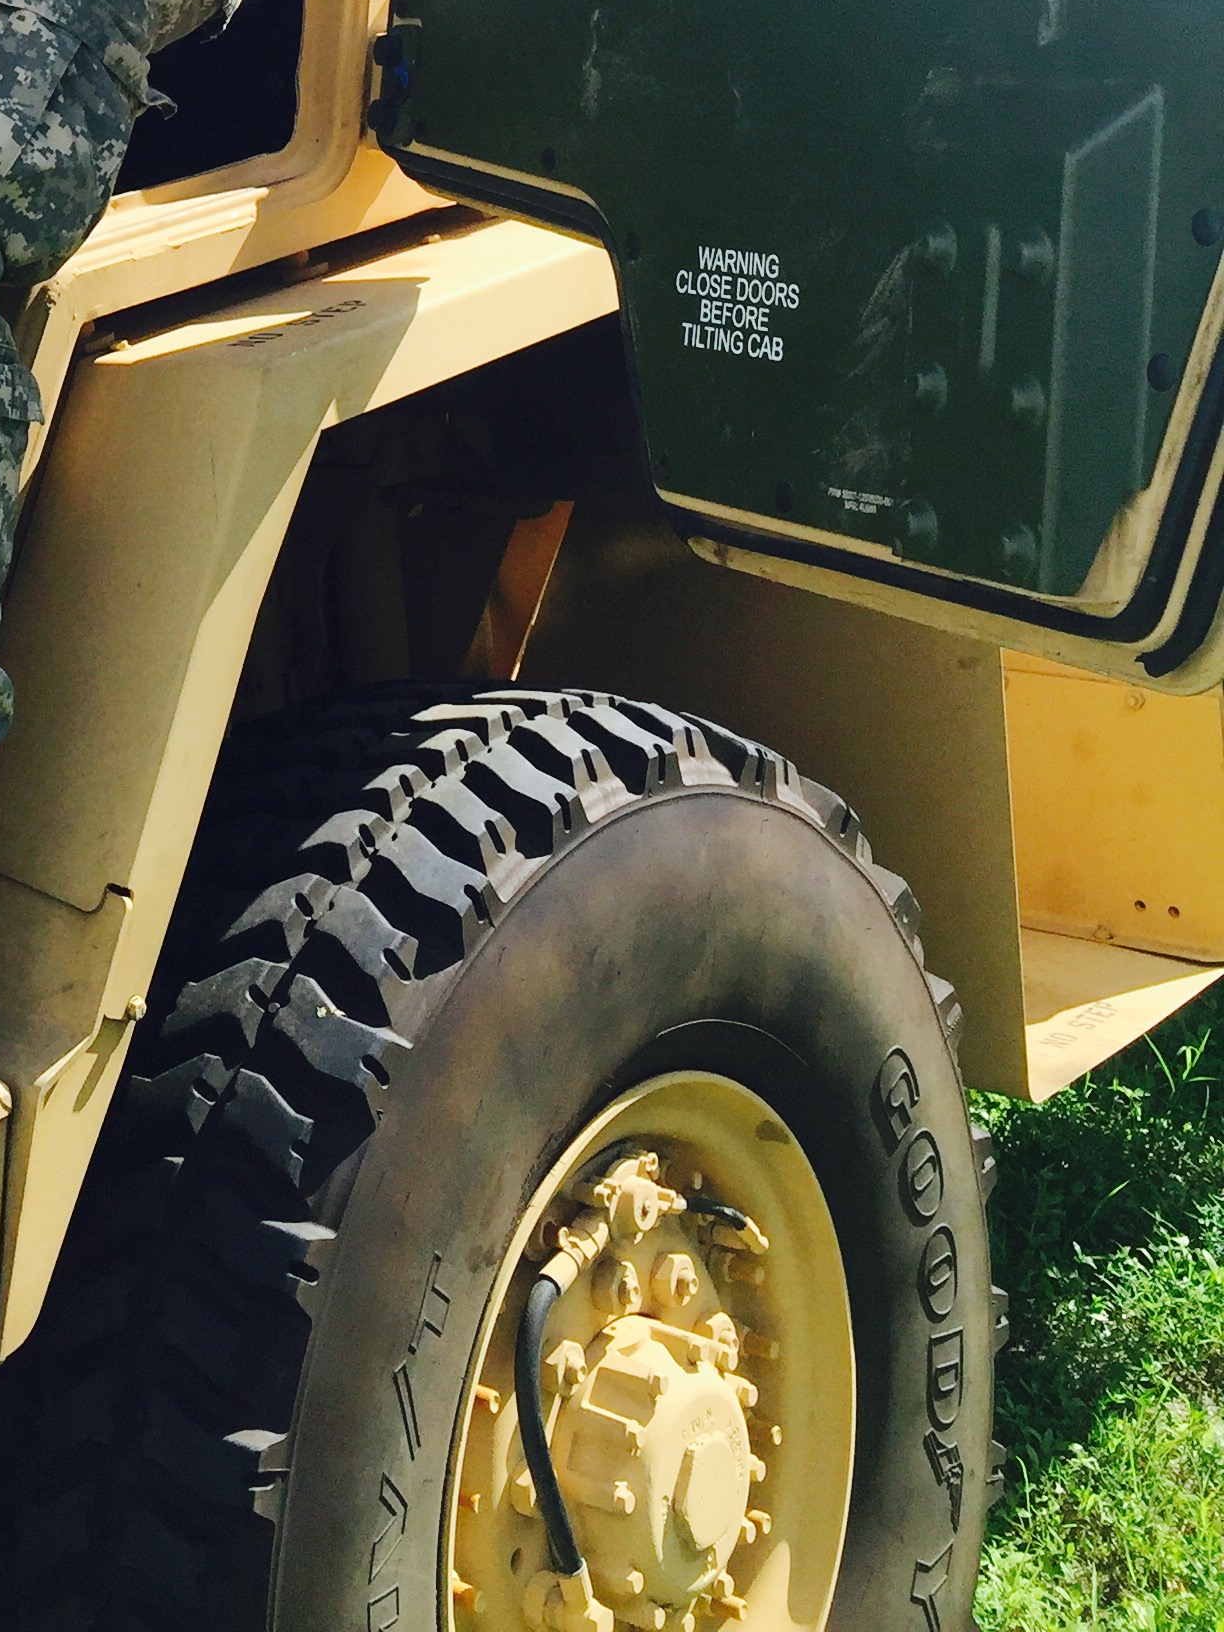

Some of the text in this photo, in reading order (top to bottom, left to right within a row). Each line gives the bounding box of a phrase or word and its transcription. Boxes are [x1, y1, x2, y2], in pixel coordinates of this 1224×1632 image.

[698, 245, 780, 279] WARNING
[676, 269, 800, 309] CLOSE DOORS
[699, 298, 770, 332] BEFORE
[681, 322, 784, 362] TILTING CAB
[1039, 1000, 1119, 1050] NO STEP
